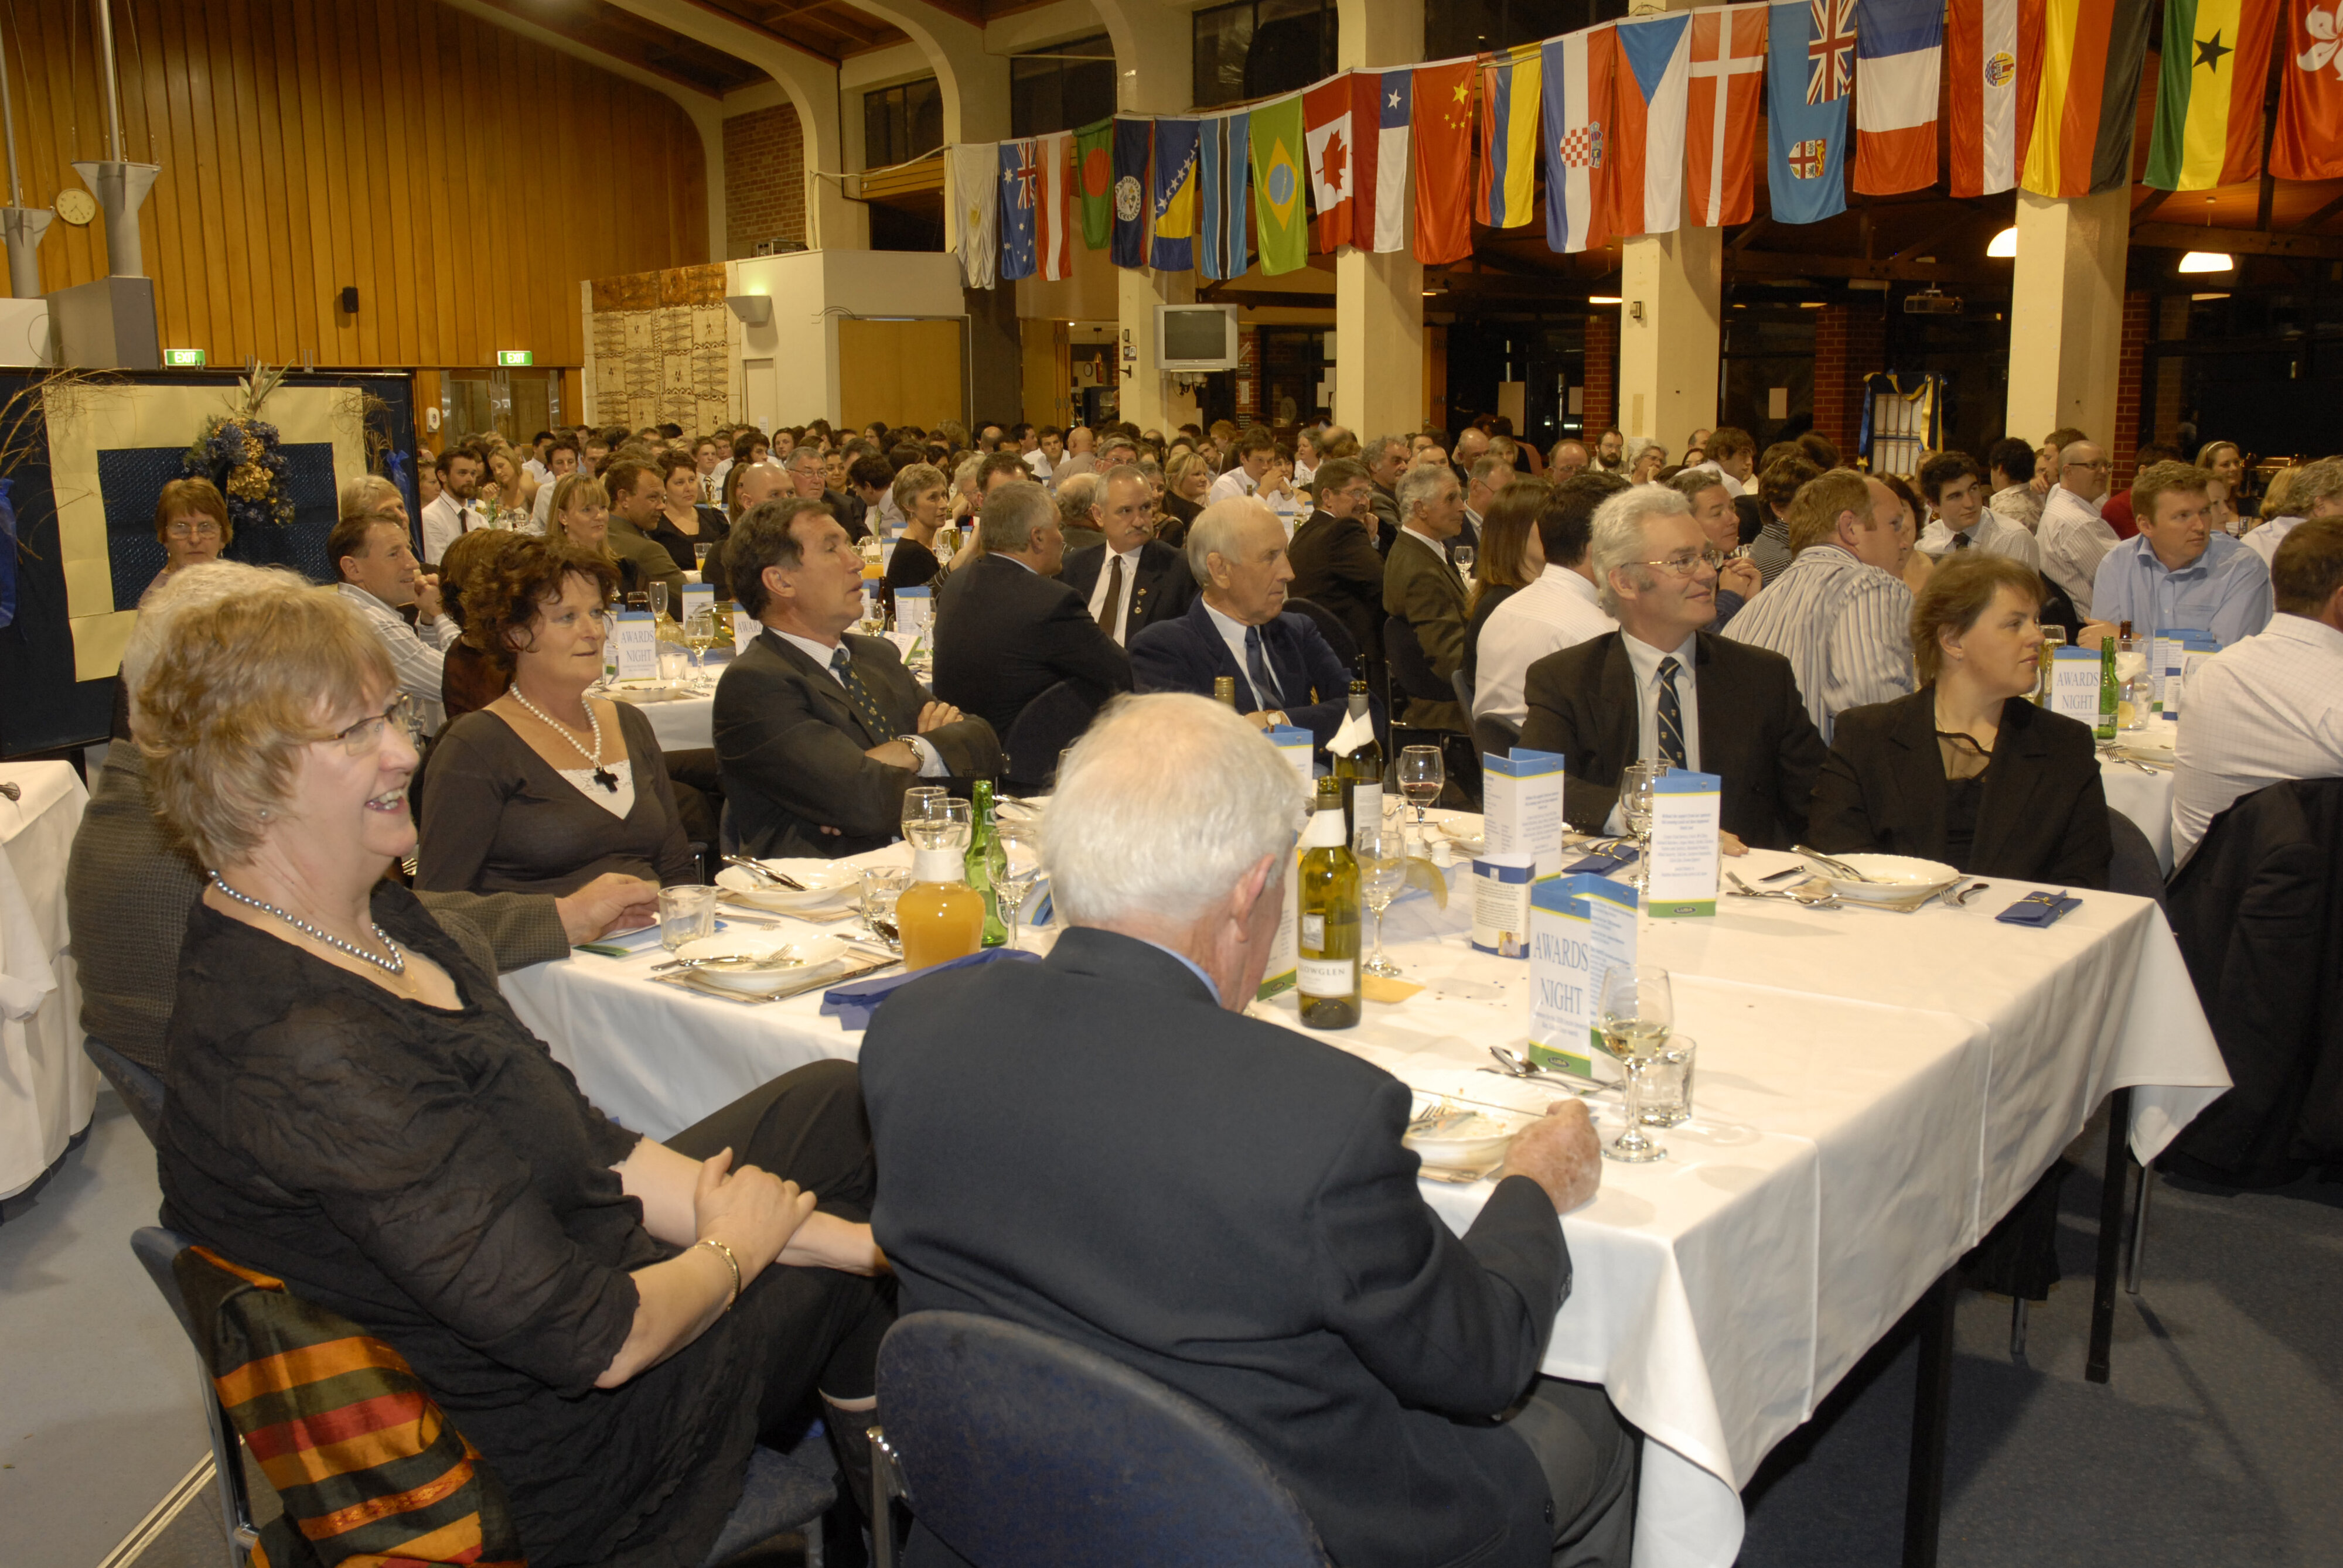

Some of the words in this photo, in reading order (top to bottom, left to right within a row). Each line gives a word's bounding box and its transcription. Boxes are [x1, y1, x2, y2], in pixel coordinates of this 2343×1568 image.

[175, 352, 196, 363] EXIT
[506, 353, 525, 364] EXIT
[621, 630, 654, 643] AWARDS
[626, 649, 652, 662] NIGHT
[2056, 672, 2099, 686] AWARDS
[2062, 695, 2094, 709] NIGHT
[1533, 932, 1589, 972] AWARDS
[1540, 977, 1583, 1015] NIGHT
